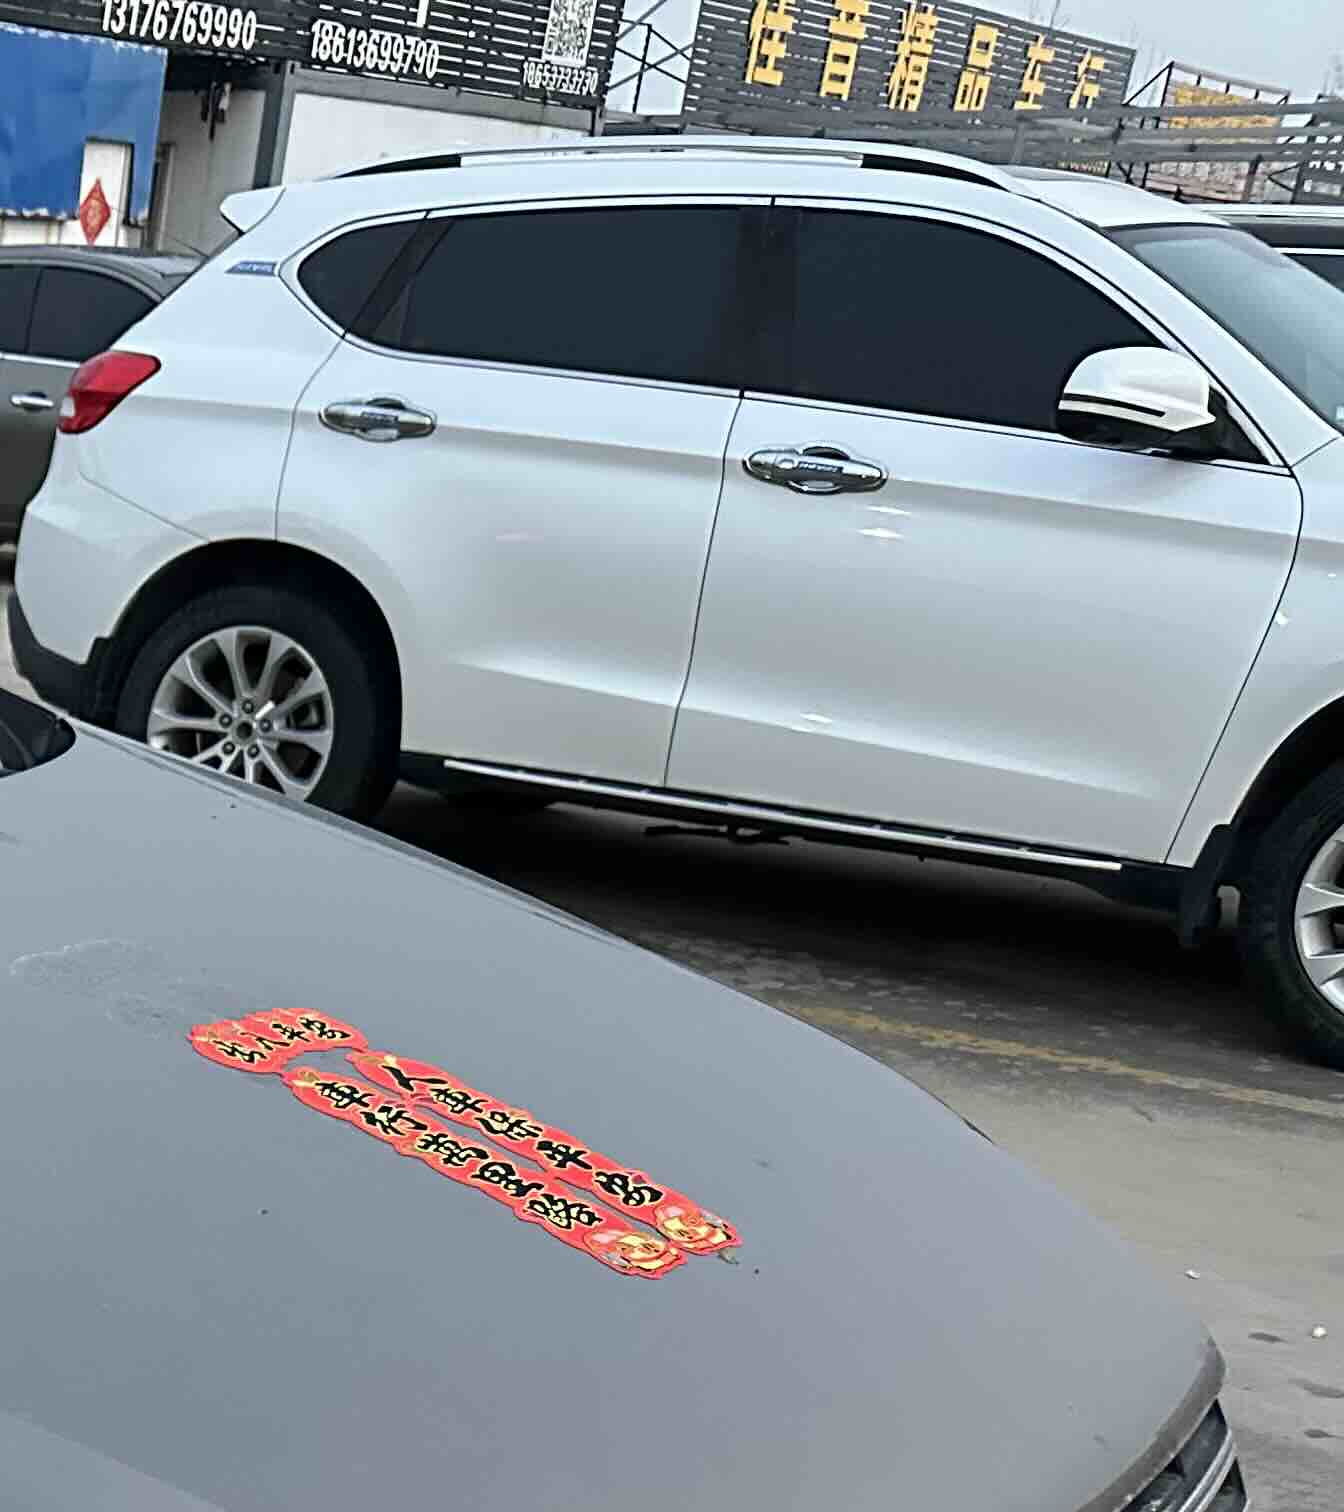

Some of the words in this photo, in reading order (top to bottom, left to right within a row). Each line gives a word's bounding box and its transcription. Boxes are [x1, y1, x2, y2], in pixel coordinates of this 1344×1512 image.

[100, 0, 257, 50] 13176769990
[311, 19, 440, 79] 18613699790
[212, 1015, 352, 1065] 出入平安
